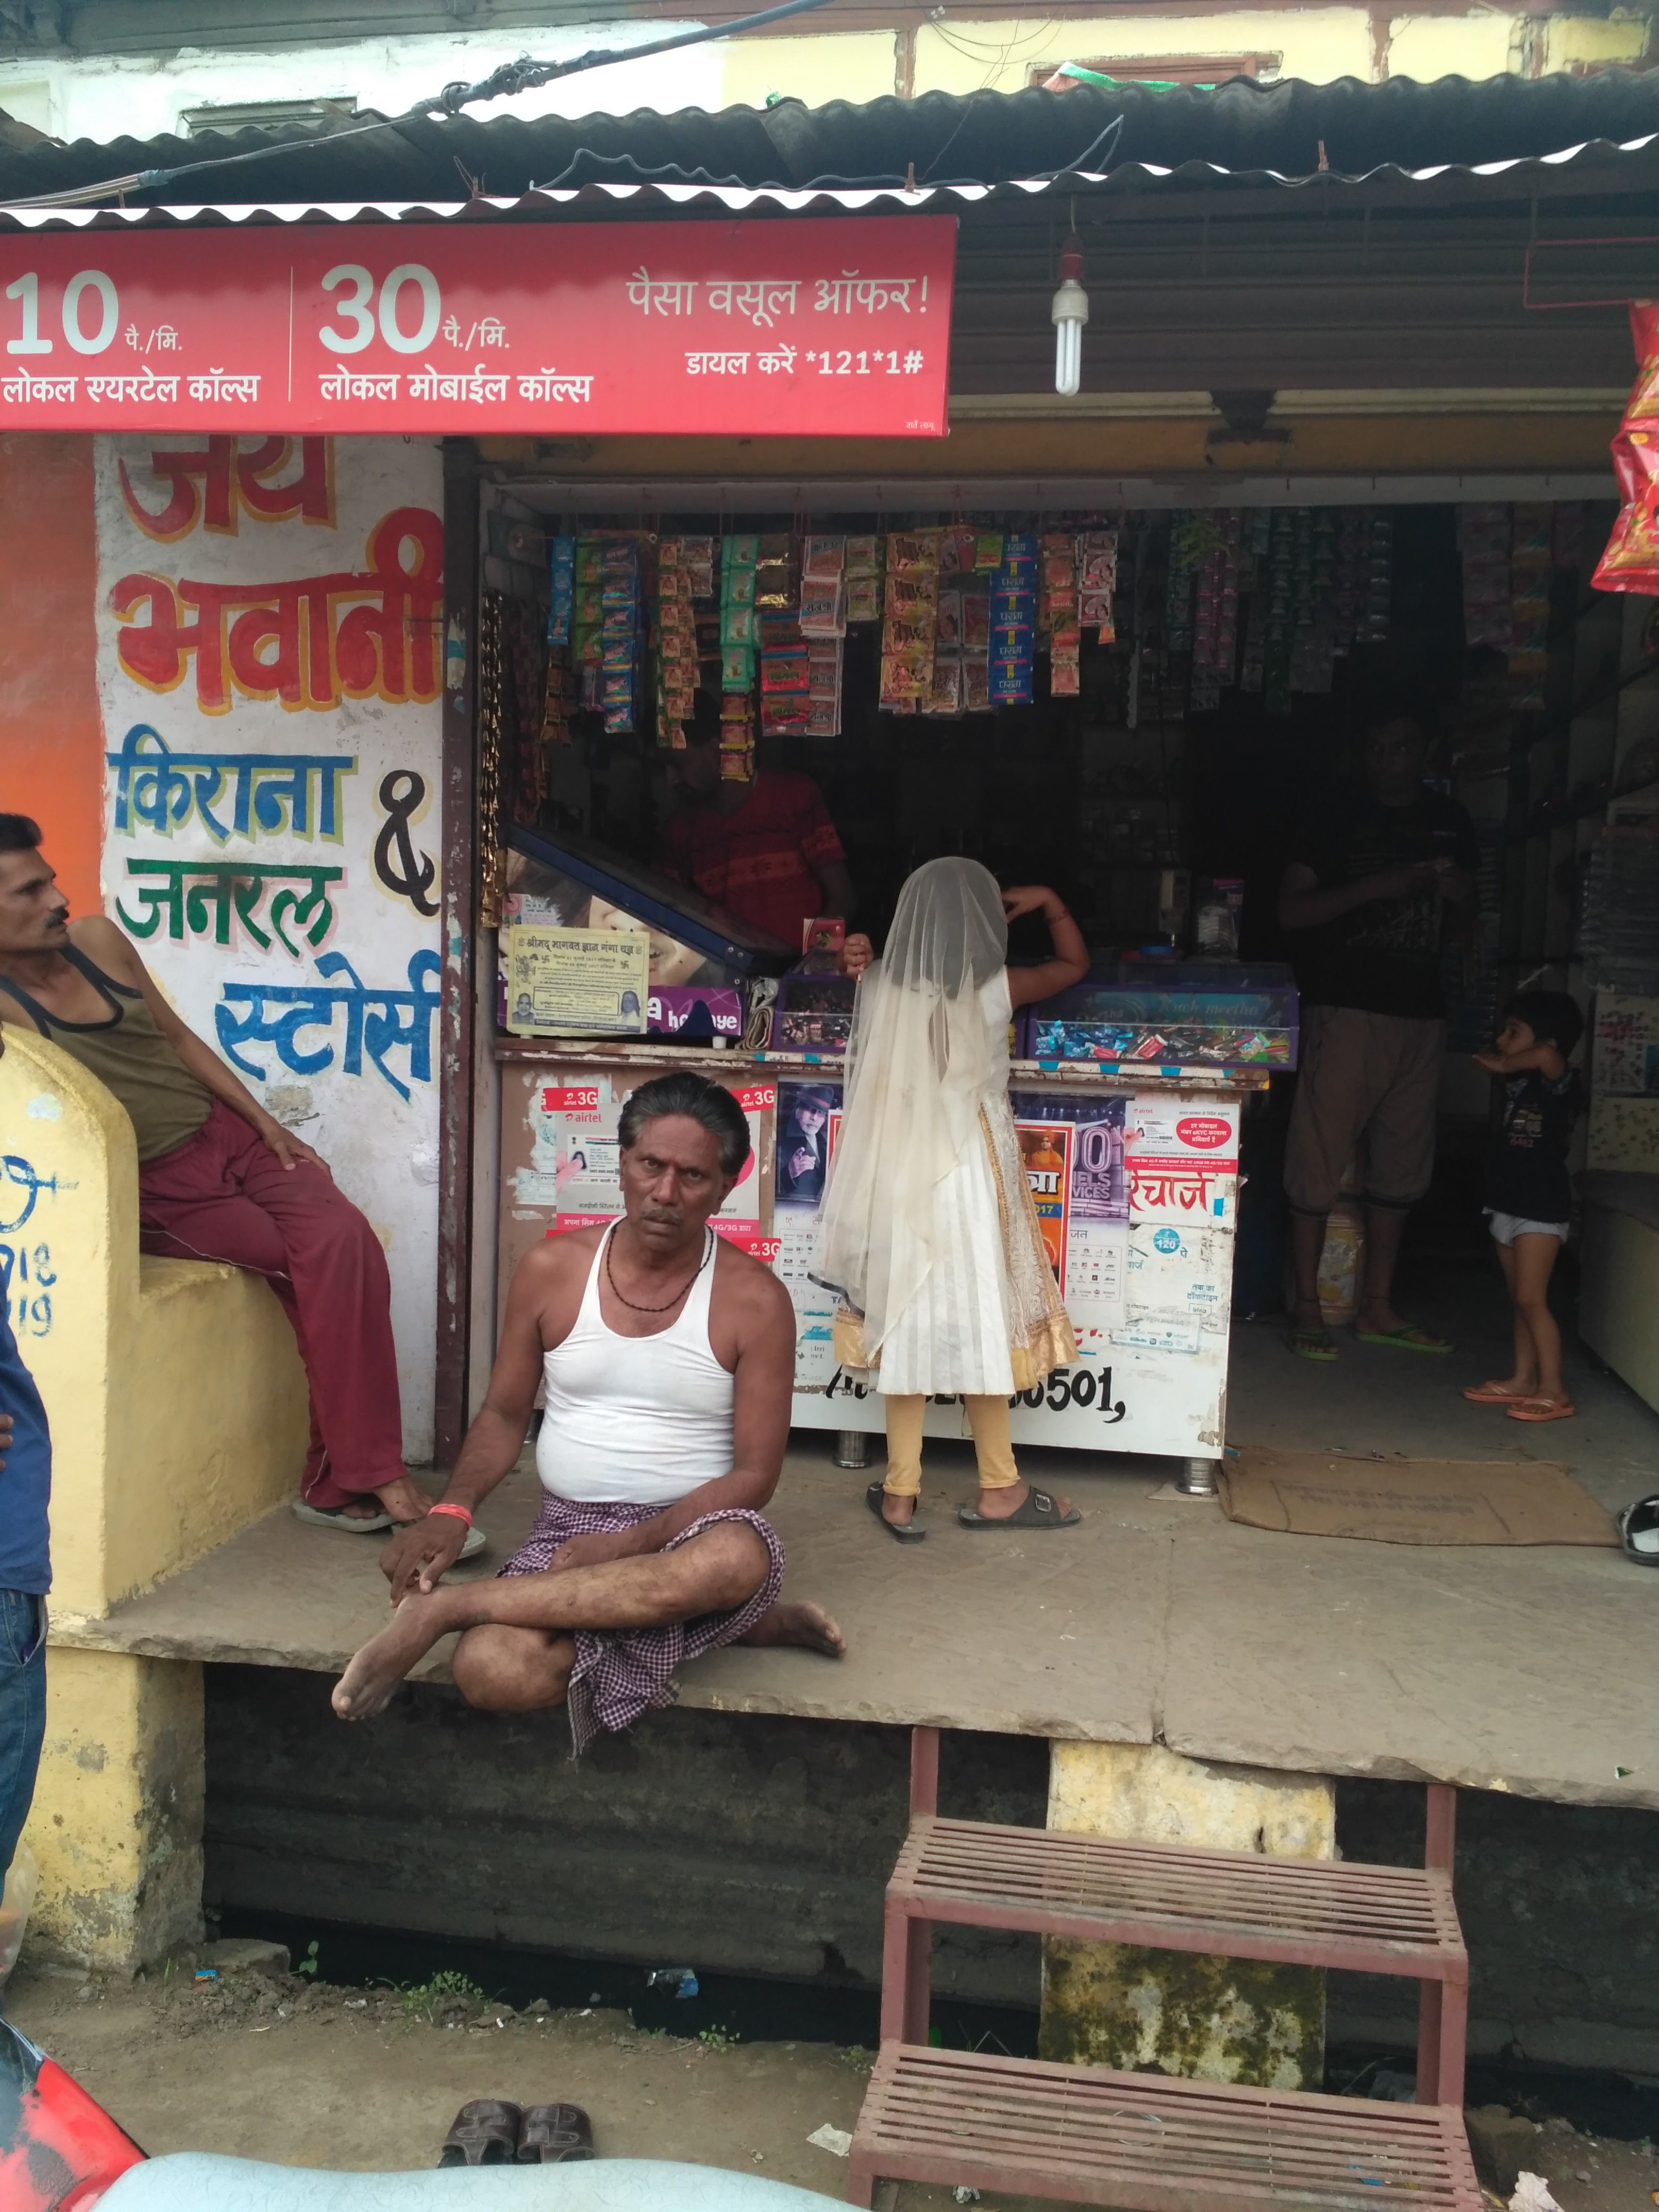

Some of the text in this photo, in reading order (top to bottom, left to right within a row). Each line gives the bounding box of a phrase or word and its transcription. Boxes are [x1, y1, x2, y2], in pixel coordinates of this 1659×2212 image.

[6, 270, 119, 354] 10
[319, 263, 441, 354] 30
[626, 266, 928, 326] पैसा वसूल ऑफर!
[684, 351, 750, 375] डायल
[756, 343, 797, 375] करें
[1, 366, 78, 403] लोकल
[187, 368, 261, 403] कॉल्स
[319, 363, 594, 404] लोकल मोबाईल कॉल्स
[118, 434, 335, 537] जय
[108, 506, 443, 713] भवानी
[106, 724, 356, 843] किराना
[374, 769, 441, 916] &
[115, 857, 347, 957] जनरल
[552, 940, 580, 951] भागवत
[601, 941, 618, 953] गंगा
[215, 949, 440, 1103] स्टोर्स
[577, 1091, 598, 1105] 3G
[754, 1089, 774, 1105] 3G
[575, 1112, 602, 1122] airtel
[581, 1218, 594, 1226] सिम
[761, 1242, 781, 1256] 3G
[1157, 1240, 1176, 1249] 120
[1205, 1284, 1216, 1292] का
